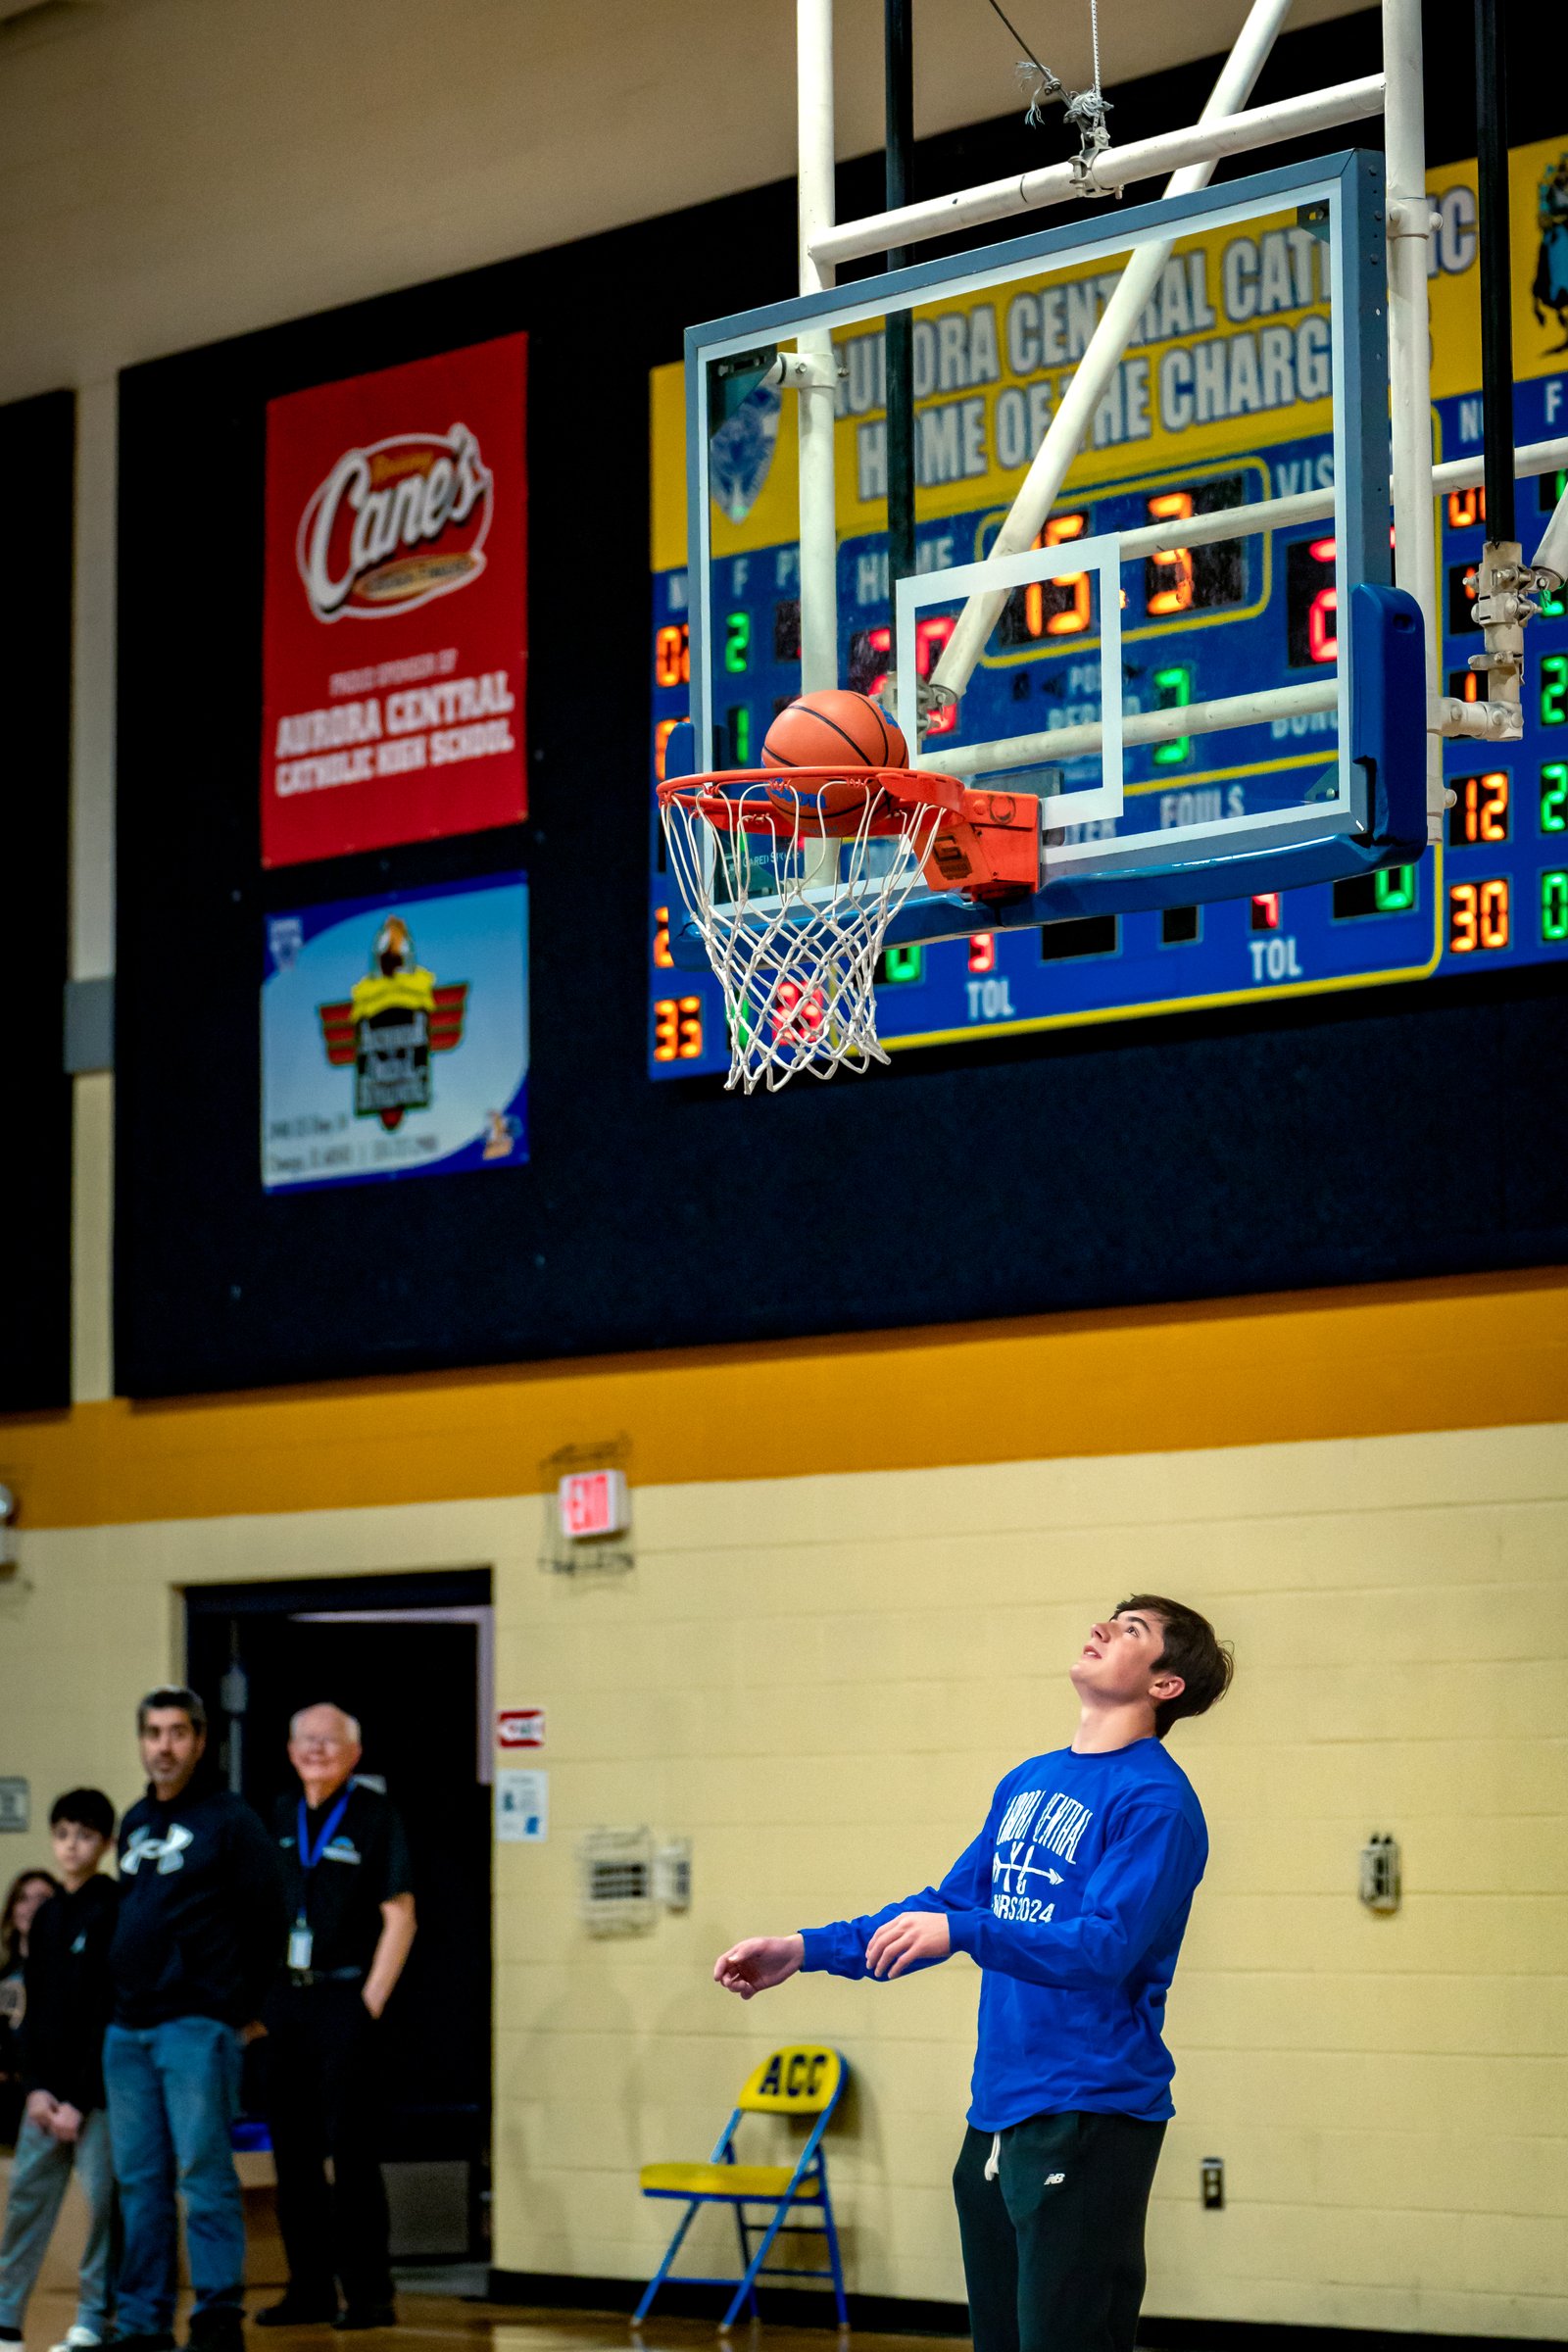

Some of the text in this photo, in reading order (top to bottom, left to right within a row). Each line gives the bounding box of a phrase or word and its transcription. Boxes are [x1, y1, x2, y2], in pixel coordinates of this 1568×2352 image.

[858, 396, 988, 504] HME
[1059, 355, 1151, 454] HE
[1544, 380, 1563, 425] F
[857, 535, 955, 607] HME
[725, 612, 751, 673] 2
[385, 669, 515, 736] CENTRAL
[1464, 770, 1509, 843] 12
[1540, 760, 1568, 833] 2
[1449, 878, 1510, 953] 30
[1250, 936, 1302, 981] TOL
[965, 980, 1015, 1020] TOL
[759, 2054, 828, 2097] ACC
